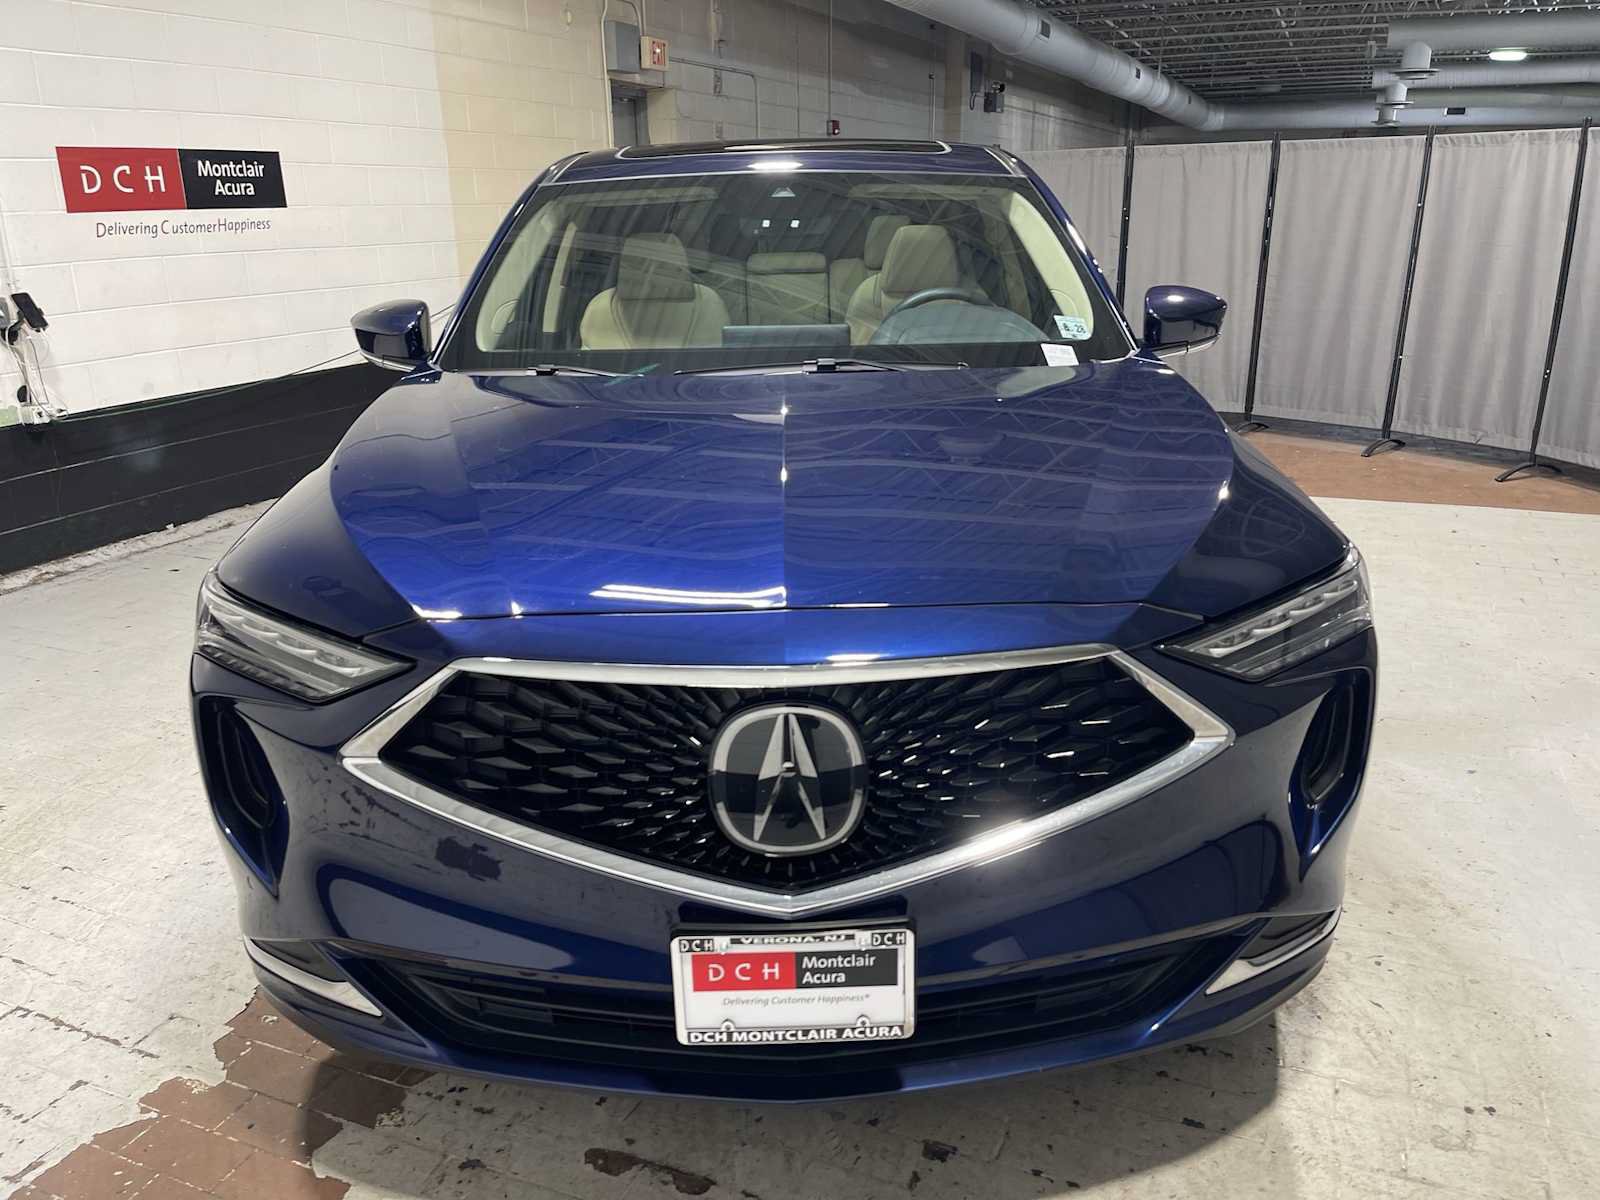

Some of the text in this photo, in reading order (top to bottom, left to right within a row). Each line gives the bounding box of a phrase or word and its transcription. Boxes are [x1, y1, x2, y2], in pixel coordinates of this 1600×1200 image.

[197, 160, 265, 178] Montclair
[214, 179, 255, 196] Acura
[96, 222, 158, 239] Delivering
[801, 953, 877, 969] Montclair
[801, 971, 847, 985] Acura
[723, 997, 770, 1007] Delivering
[770, 995, 816, 1006] Customer
[689, 1025, 903, 1044] DCH MONTCLAIR ACURA
